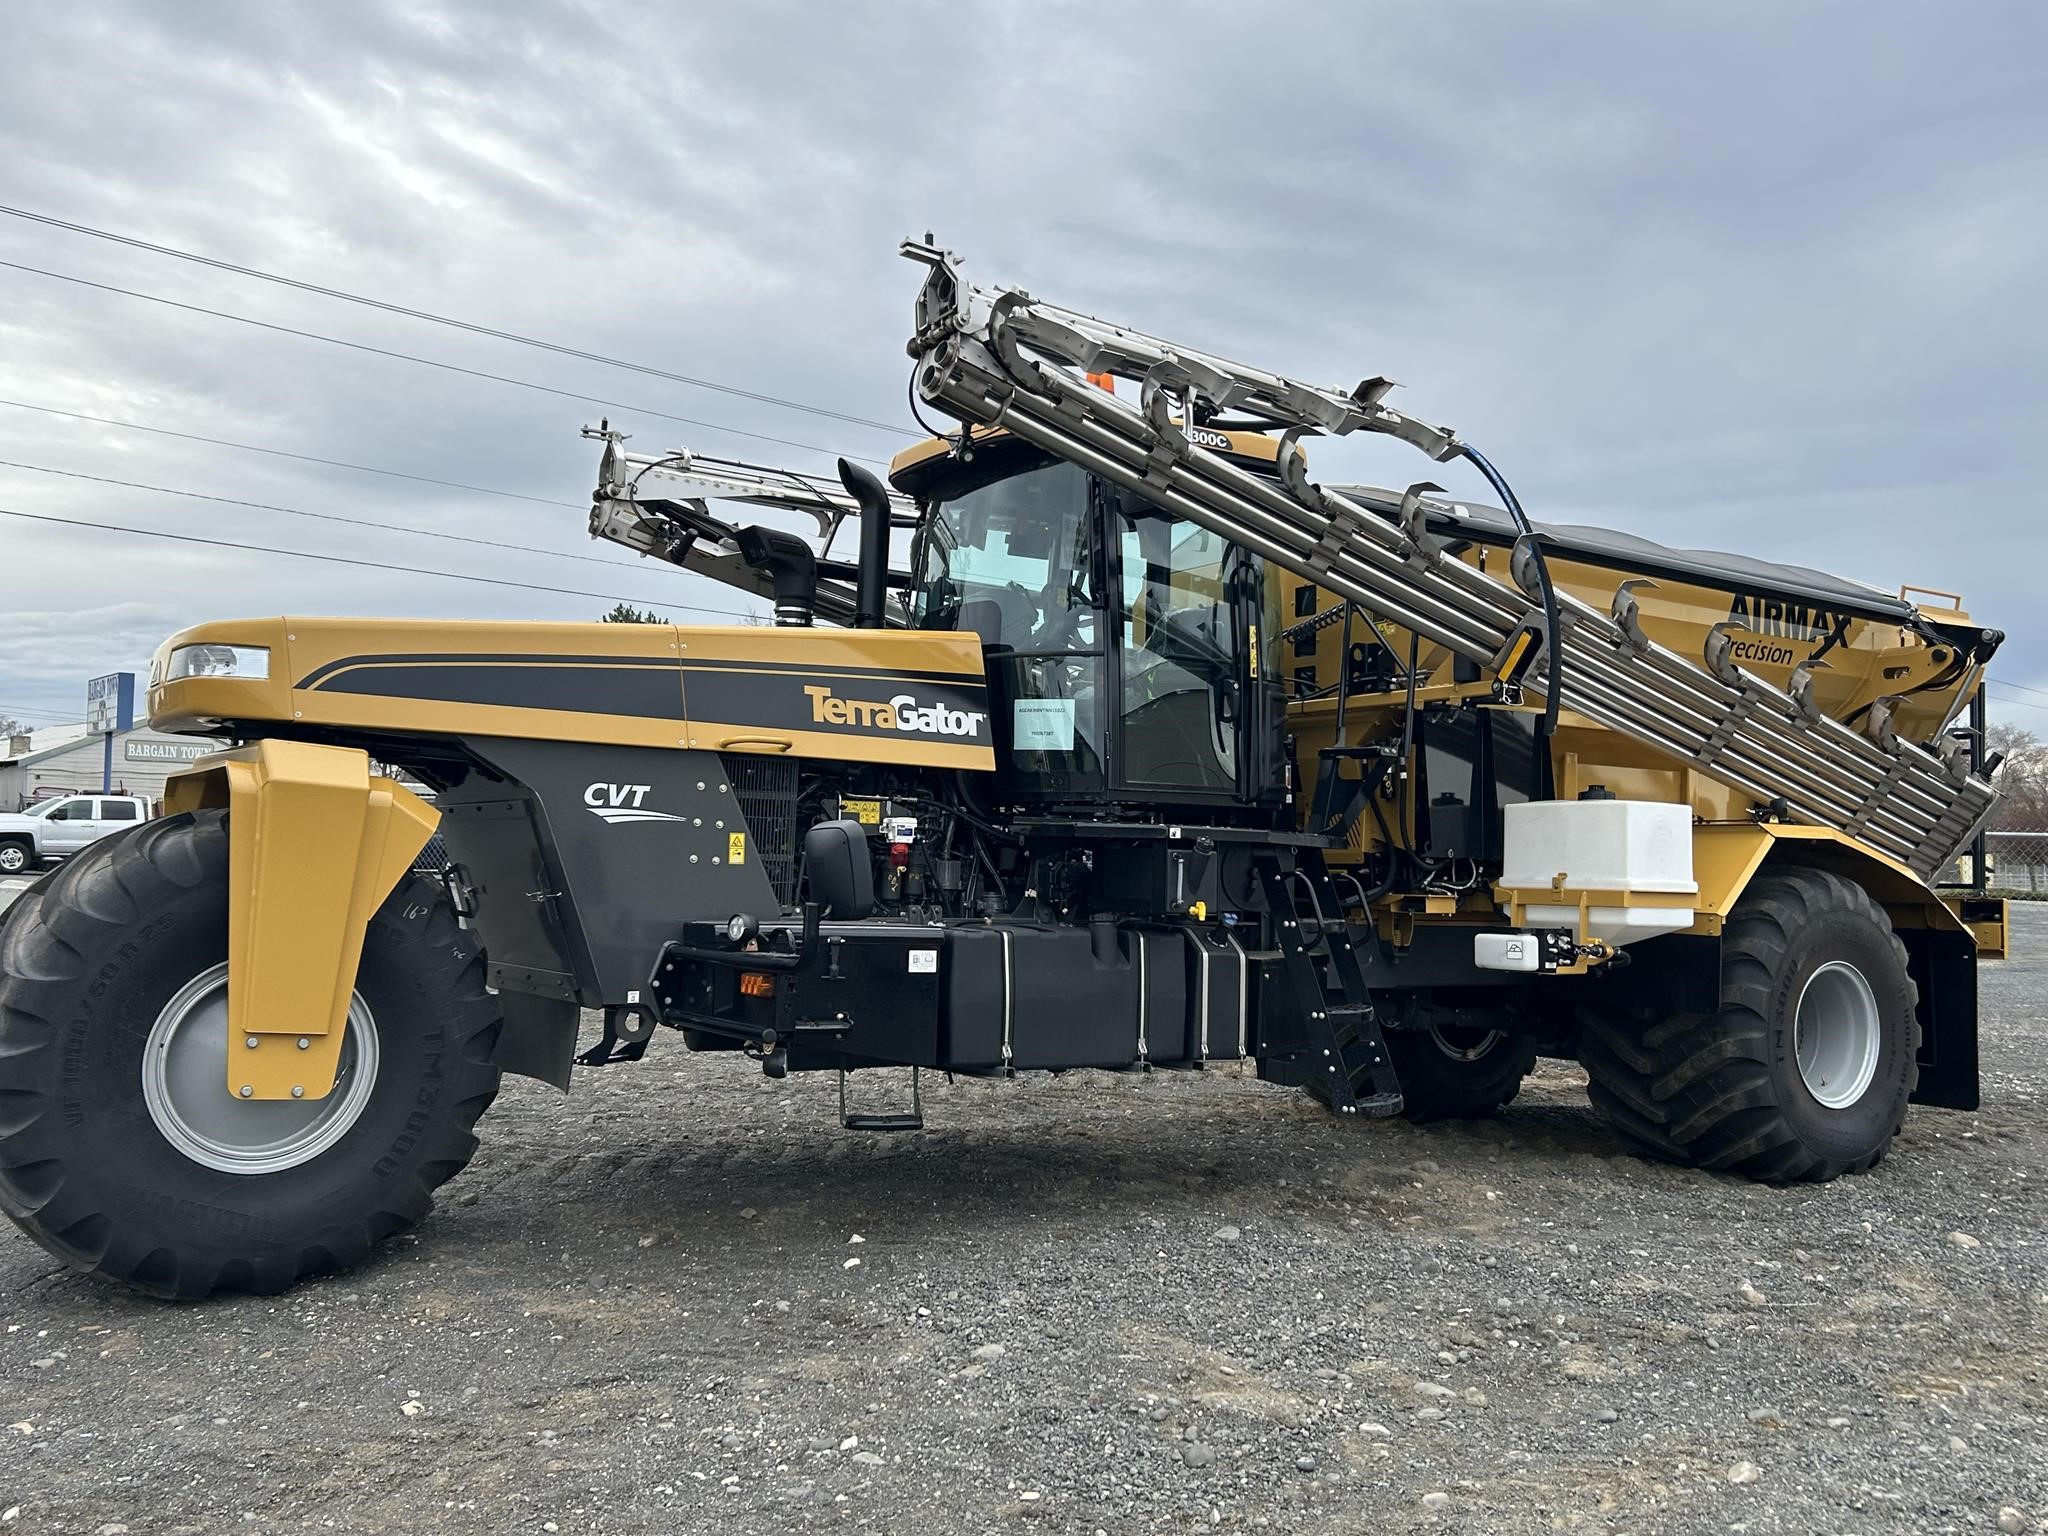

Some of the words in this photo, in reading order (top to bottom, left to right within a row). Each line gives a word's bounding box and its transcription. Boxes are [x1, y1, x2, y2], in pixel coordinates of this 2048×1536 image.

[1727, 593, 1852, 662] AIRMAX
[804, 685, 984, 737] TerraGator
[128, 743, 178, 758] BARGAIN
[584, 782, 651, 807] CVT
